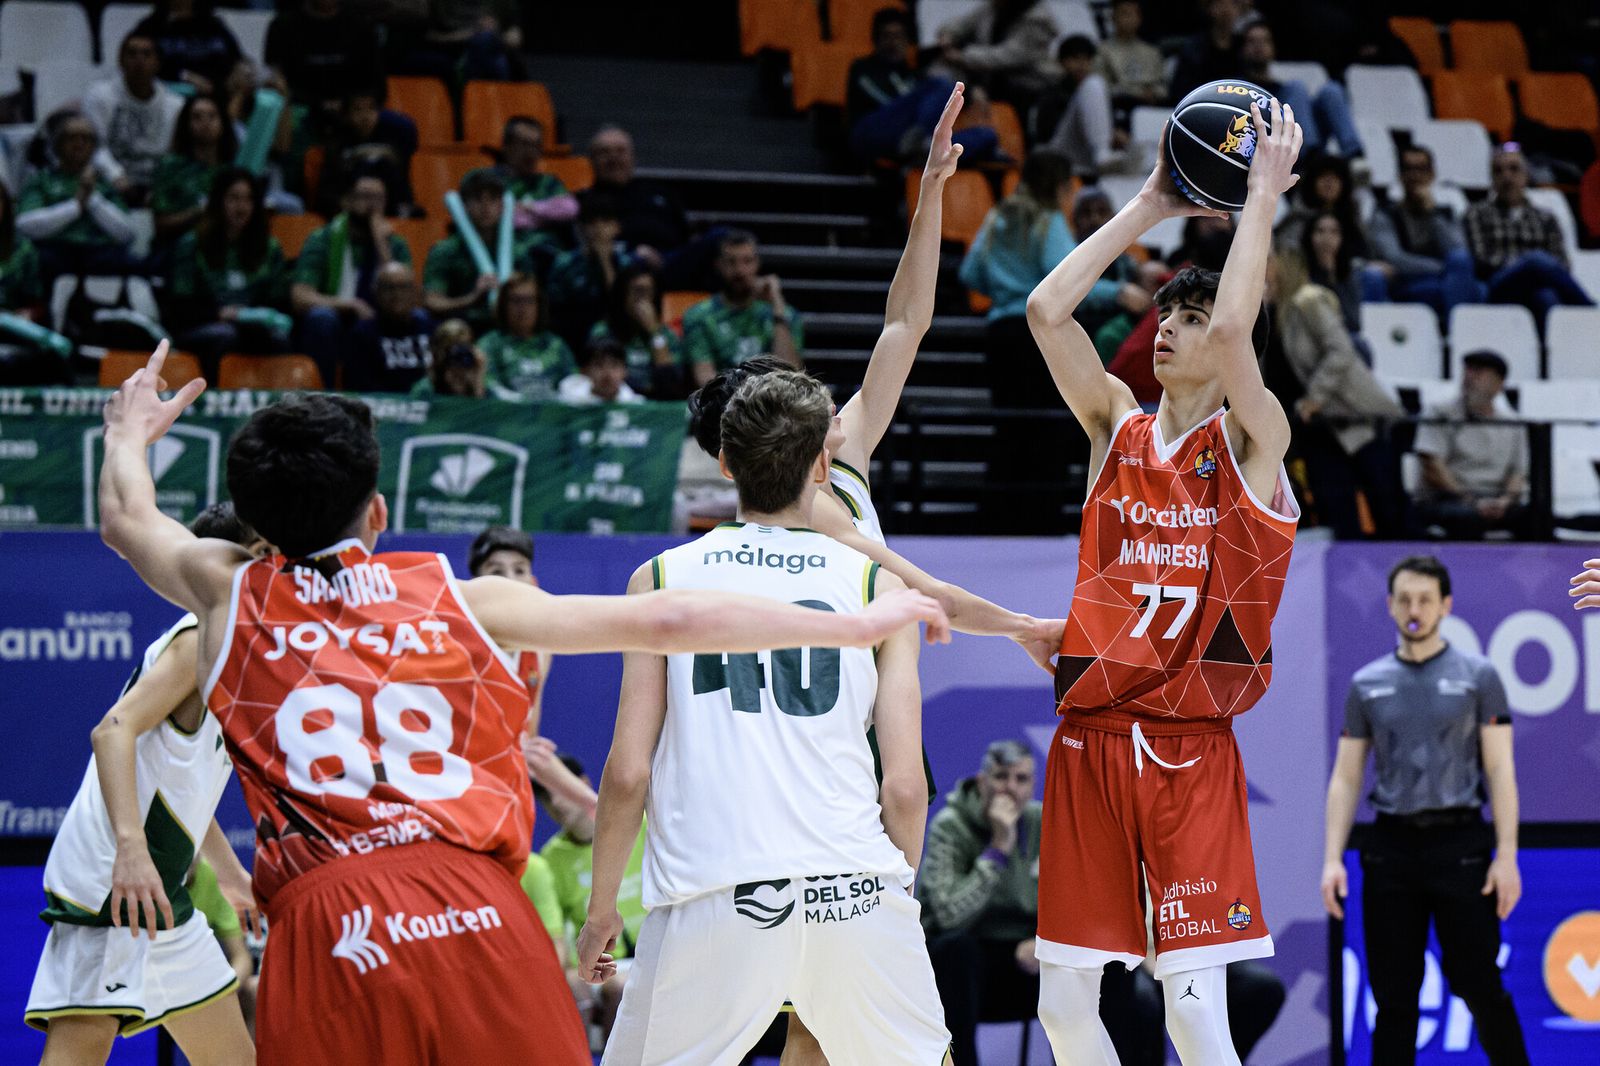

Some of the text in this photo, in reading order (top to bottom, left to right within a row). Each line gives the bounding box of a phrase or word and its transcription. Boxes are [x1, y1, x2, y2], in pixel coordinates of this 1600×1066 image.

[1130, 498, 1219, 529] Occiden
[1119, 538, 1210, 571] MANRESA
[1129, 582, 1198, 640] 77
[0, 628, 132, 661] anum
[264, 618, 449, 661] JOYSAT
[692, 599, 841, 717] 40
[275, 682, 474, 801] 88
[803, 885, 846, 905] DEL
[849, 876, 885, 899] SOL
[1162, 877, 1218, 903] Adbisio
[384, 903, 502, 944] Kouten
[804, 895, 881, 924] MÁLAGA
[1159, 900, 1190, 924] ETL
[1159, 919, 1222, 941] GLOBAL
